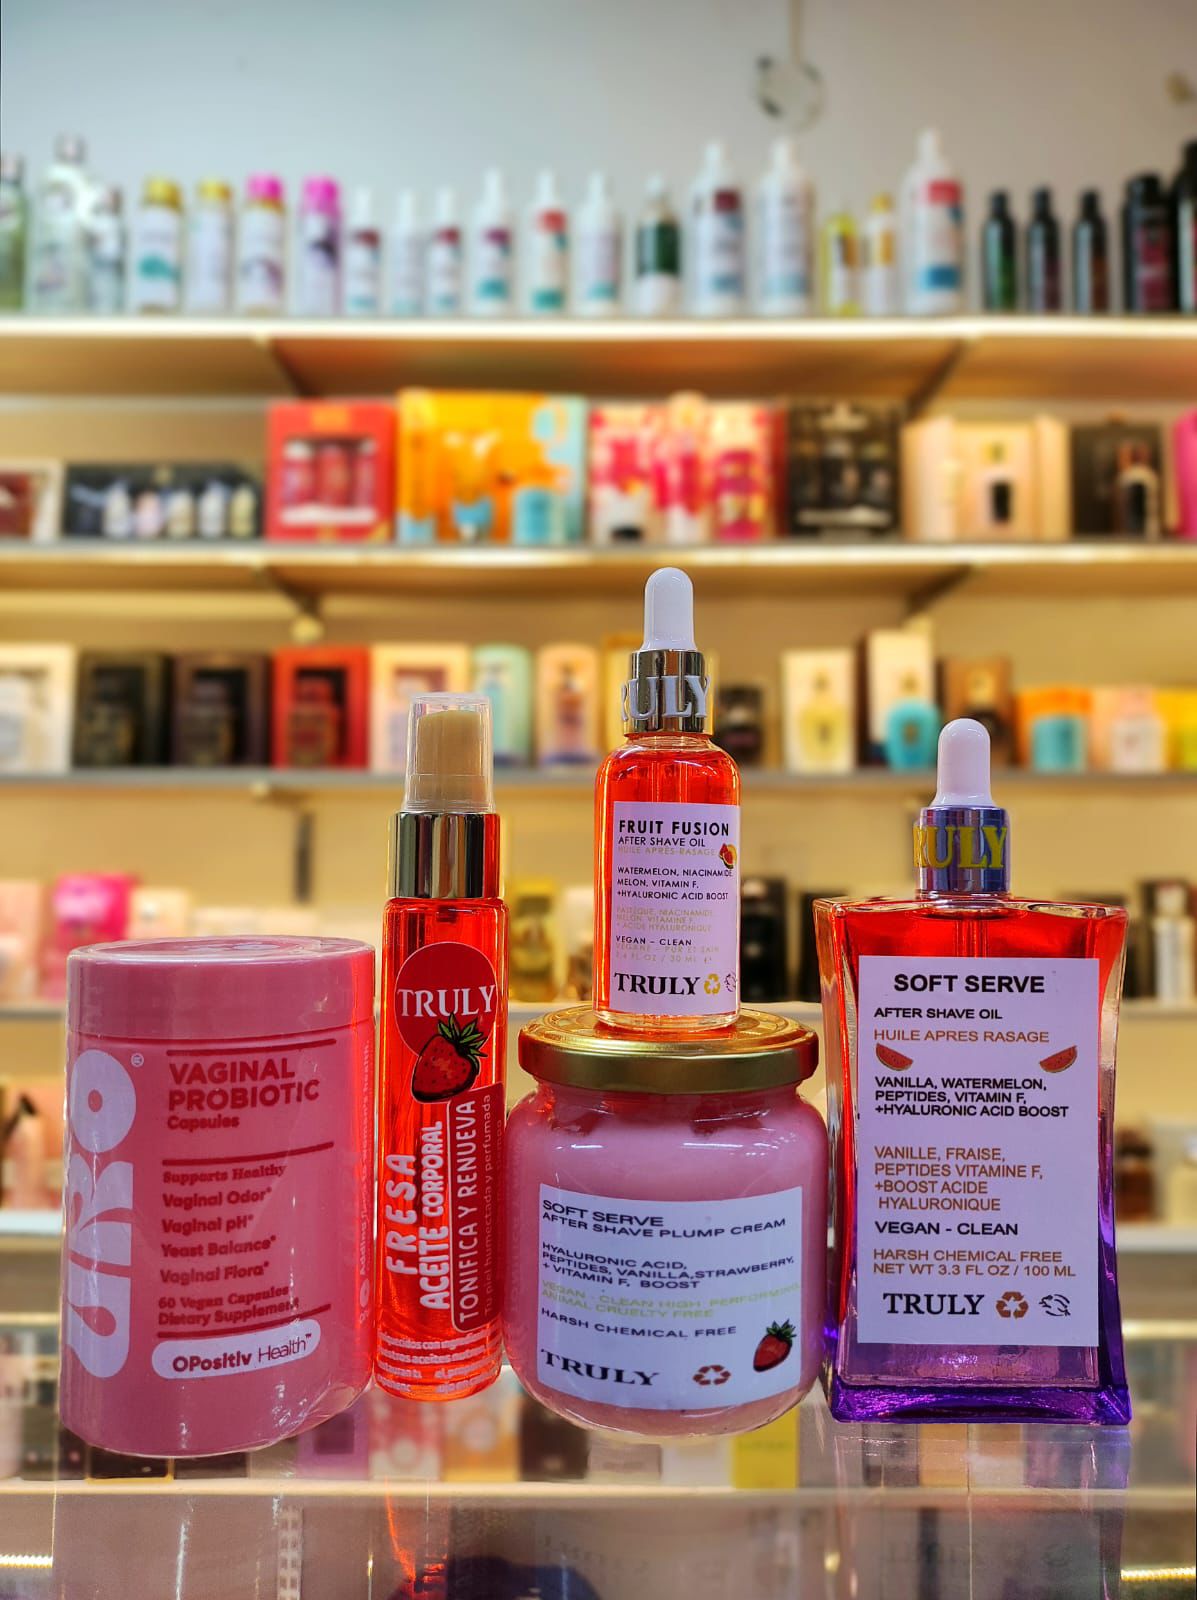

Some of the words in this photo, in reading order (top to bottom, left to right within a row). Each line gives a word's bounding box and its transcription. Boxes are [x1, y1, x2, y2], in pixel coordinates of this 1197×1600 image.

[619, 820, 664, 834] FRUIT
[671, 821, 729, 836] FUSION
[618, 836, 646, 846] AFTER
[650, 837, 686, 847] SHAVE
[689, 838, 706, 848] OIL
[617, 866, 679, 876] WATERMELON,
[652, 880, 690, 889] VITAMIN
[617, 890, 678, 900] +HYALURONIC
[681, 892, 704, 901] ACID
[706, 892, 728, 901] BOOST
[616, 935, 646, 945] VEGAN
[659, 938, 692, 946] CLEAN
[614, 972, 701, 995] TRULY
[894, 973, 958, 992] SOFT
[964, 975, 1045, 993] SERVE
[397, 984, 496, 1017] TRULY
[873, 1007, 923, 1018] AFTER
[926, 1008, 975, 1019] SHAVE
[979, 1008, 1003, 1020] OIL
[874, 1028, 921, 1041] HUILE
[924, 1029, 979, 1042] APRES
[983, 1030, 1050, 1043] RASAGE
[169, 1057, 296, 1085] VAGINAL
[875, 1076, 937, 1090] VANILLA,
[941, 1077, 1047, 1091] WATERMELON,
[168, 1079, 320, 1112] PROBIOTIC
[875, 1091, 950, 1104] PEPTIDES,
[954, 1092, 1012, 1103] VITAMIN
[1016, 1093, 1027, 1104] F,
[875, 1104, 977, 1117] +HYALURONIC
[980, 1105, 1014, 1117] ACID
[1018, 1106, 1069, 1118] BOOST
[167, 1114, 240, 1132] Capsules
[482, 1094, 493, 1172] perfumada
[456, 1101, 478, 1198] RENUEVA
[874, 1146, 941, 1161] VANILLE,
[945, 1147, 1006, 1162] FRAISE,
[163, 1171, 228, 1186] Supports
[232, 1164, 287, 1181] Healthy
[421, 1121, 444, 1217] CORPORAL
[874, 1163, 951, 1177] PEPTIDES
[955, 1164, 1027, 1178] VITAMINE
[1031, 1165, 1043, 1179] F,
[874, 1180, 938, 1194] +BOOST
[940, 1181, 988, 1194] ACIDE
[162, 1192, 223, 1210] Vaginal
[878, 1197, 1001, 1212] HYALURONIQUE
[385, 1154, 418, 1275] FRESA
[457, 1205, 478, 1218] Y
[542, 1199, 589, 1219] SOFT
[592, 1211, 664, 1227] SERVE
[162, 1217, 222, 1236] Vaginal
[542, 1211, 588, 1230] AFTER
[592, 1223, 654, 1238] SHAVE
[660, 1228, 725, 1239] PLUMP
[730, 1218, 786, 1235] CREAM
[874, 1221, 940, 1235] VEGAN
[957, 1223, 1019, 1236] CLEAN
[161, 1243, 204, 1257] Yeast
[542, 1241, 637, 1268] HYALURONIC
[641, 1261, 687, 1270] ACID,
[873, 1249, 929, 1261] HARSH
[933, 1249, 1017, 1262] CHEMICAL
[1020, 1250, 1063, 1262] FREE
[160, 1266, 220, 1286] Vaginal
[418, 1226, 450, 1310] ACEITE
[458, 1222, 479, 1324] TONIFICA
[553, 1265, 613, 1284] VITAMIN
[640, 1281, 701, 1289] BOOST
[873, 1263, 905, 1275] NET
[909, 1263, 934, 1275] WT
[938, 1264, 961, 1275] 3.3
[965, 1265, 984, 1276] FL
[987, 1265, 1010, 1276] OZ
[1013, 1265, 1019, 1276] /
[1024, 1265, 1050, 1276] 100
[1054, 1266, 1076, 1277] ML
[158, 1297, 176, 1309] 60
[180, 1297, 224, 1312] Vegan
[228, 1286, 289, 1306] Capsules
[882, 1292, 985, 1315] TRULY
[158, 1312, 211, 1326] Dietary
[214, 1297, 300, 1324] Supplement
[541, 1307, 589, 1329] HARSH
[594, 1323, 688, 1338] CHEMICAL
[695, 1326, 737, 1337] FREE
[172, 1350, 252, 1373] OPositiv
[540, 1348, 660, 1386] TRULY
